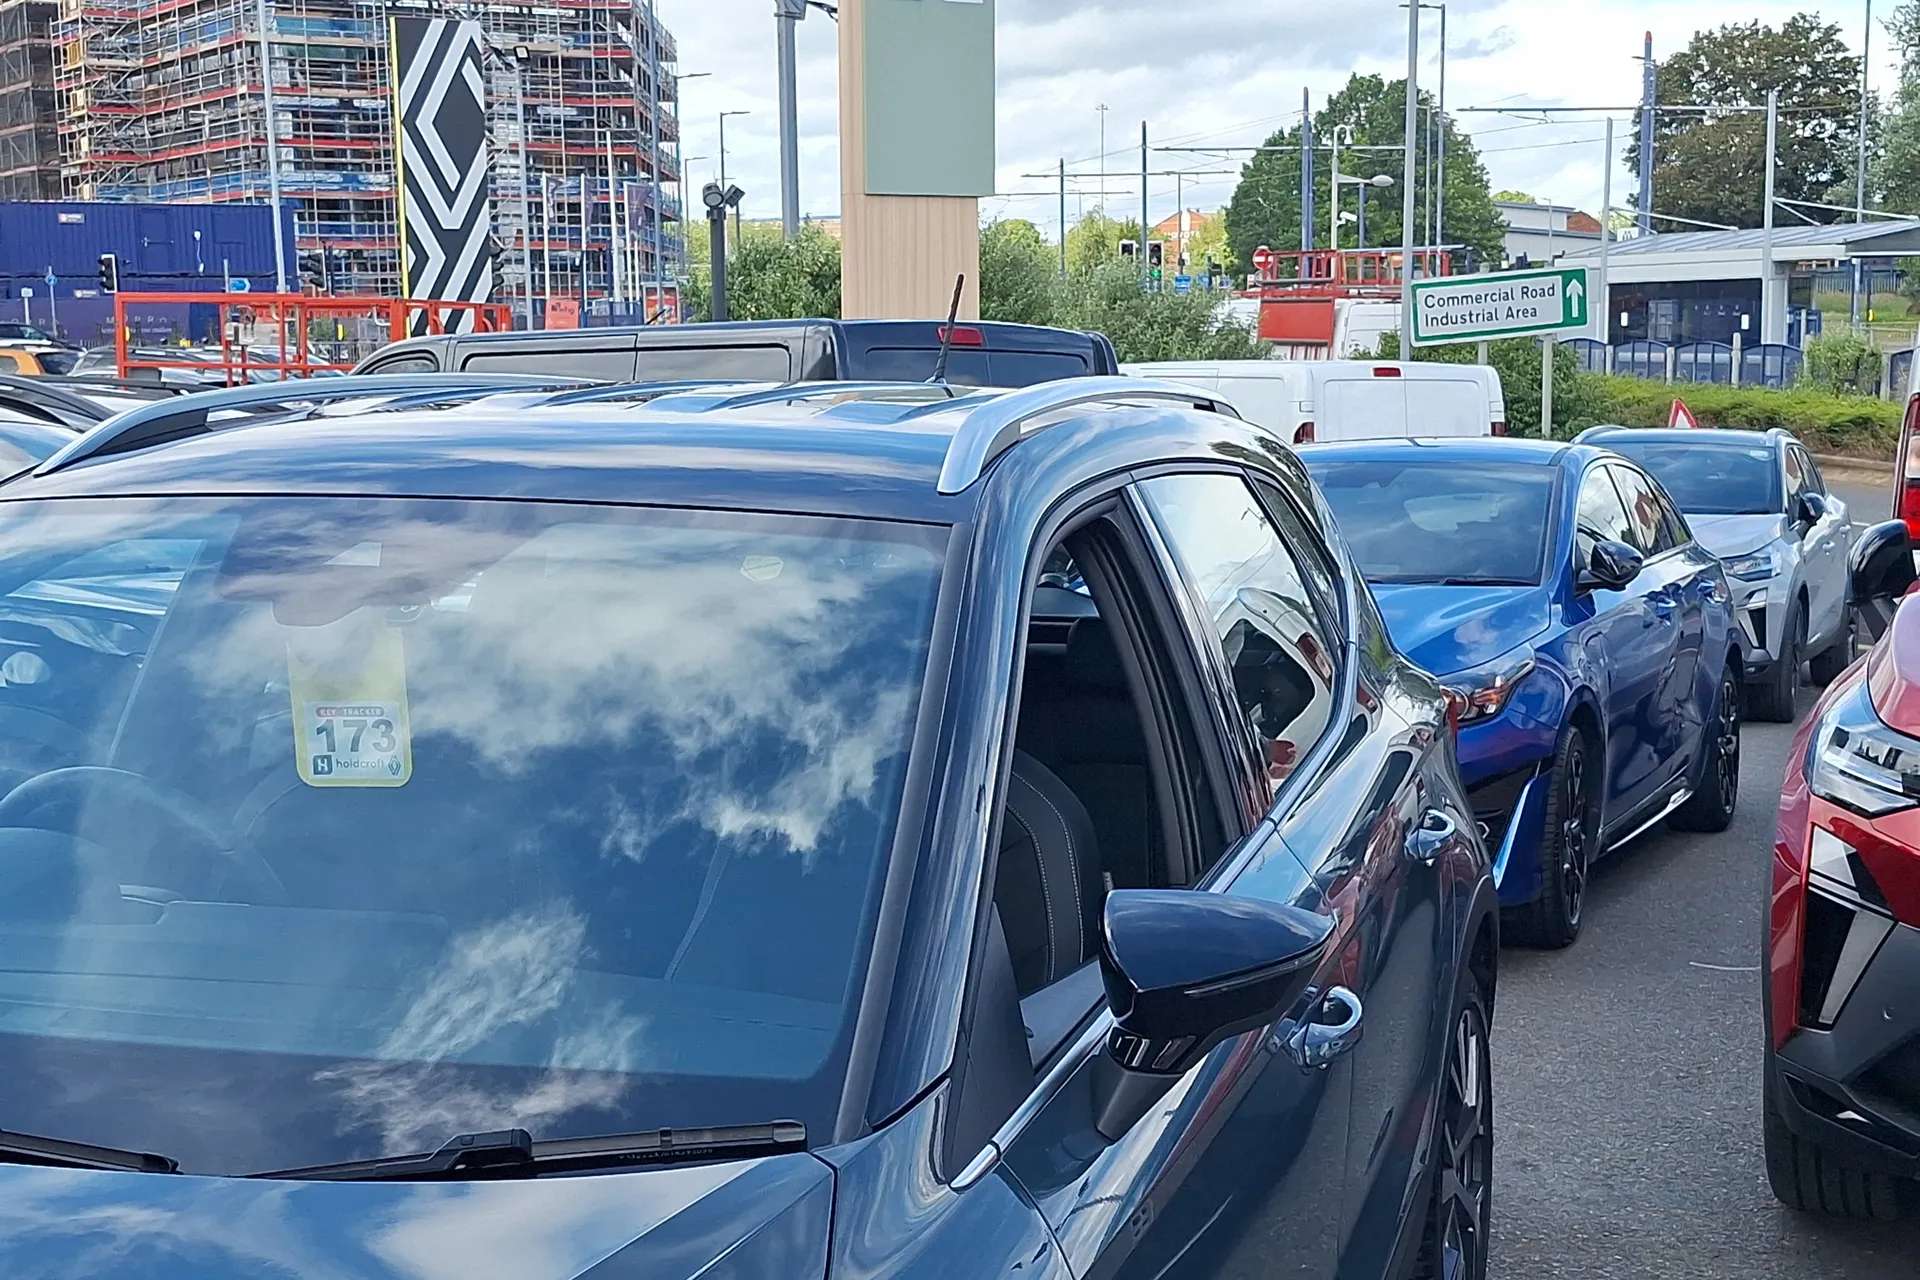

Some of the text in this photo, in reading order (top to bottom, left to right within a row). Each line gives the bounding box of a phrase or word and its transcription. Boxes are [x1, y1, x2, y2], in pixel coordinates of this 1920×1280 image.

[1424, 283, 1555, 309] Commercial Road
[1425, 306, 1537, 327] Industrial Area
[316, 718, 397, 753] 173
